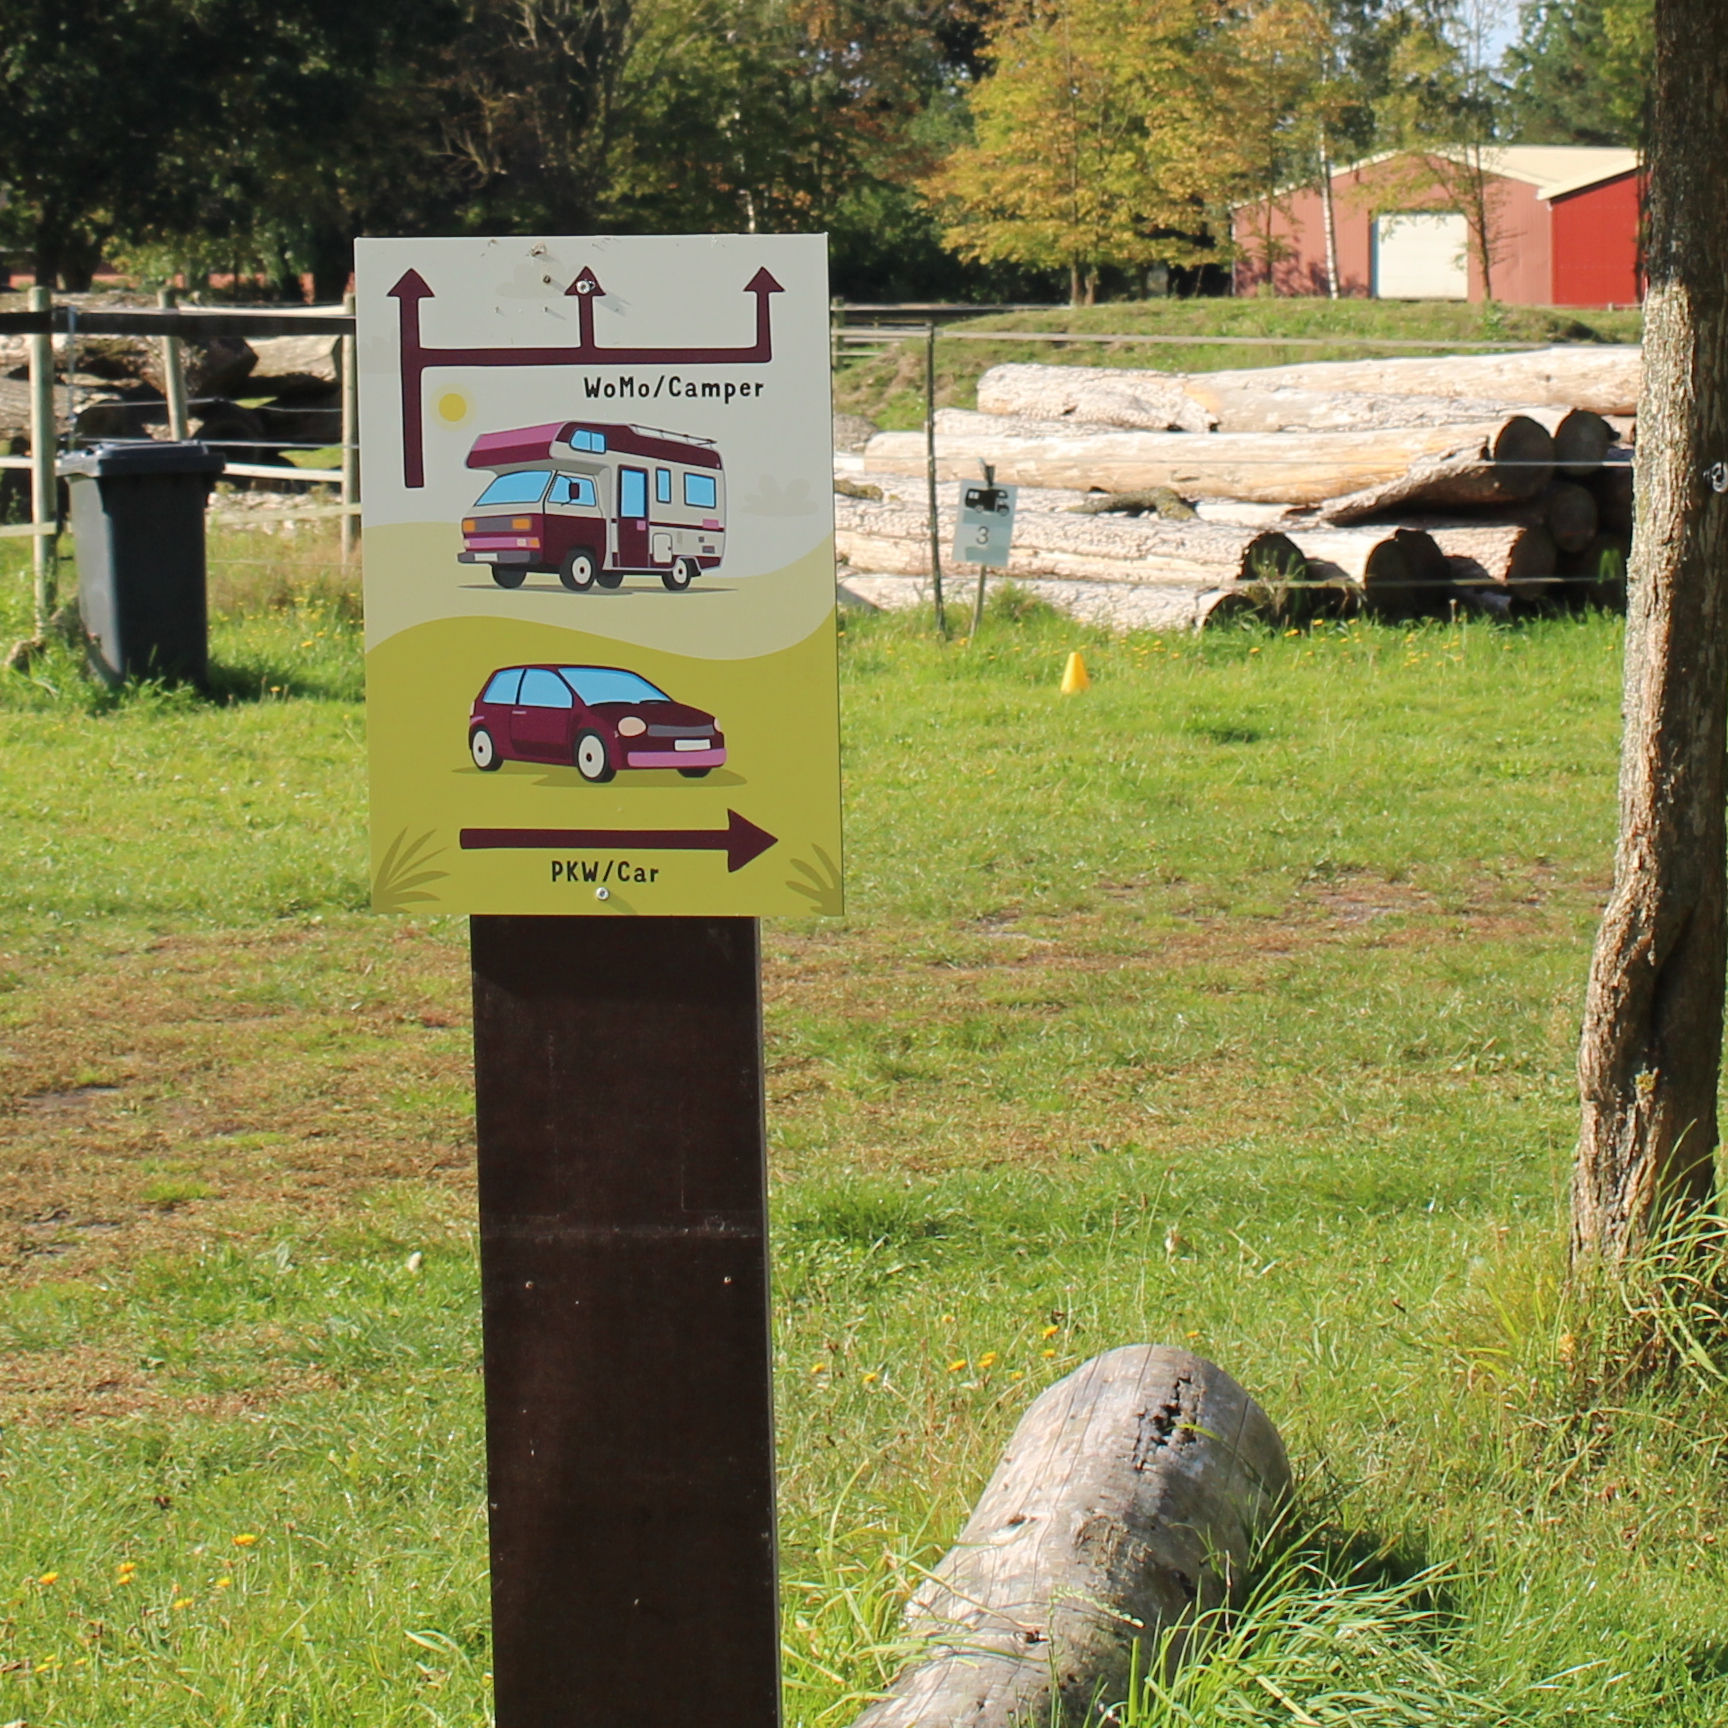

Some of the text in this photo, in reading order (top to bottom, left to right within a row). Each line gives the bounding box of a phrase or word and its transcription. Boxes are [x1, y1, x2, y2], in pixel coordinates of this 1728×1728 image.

[583, 375, 765, 404] WoMo/Camper
[976, 526, 989, 545] 3
[551, 859, 660, 883] PKW/Car
